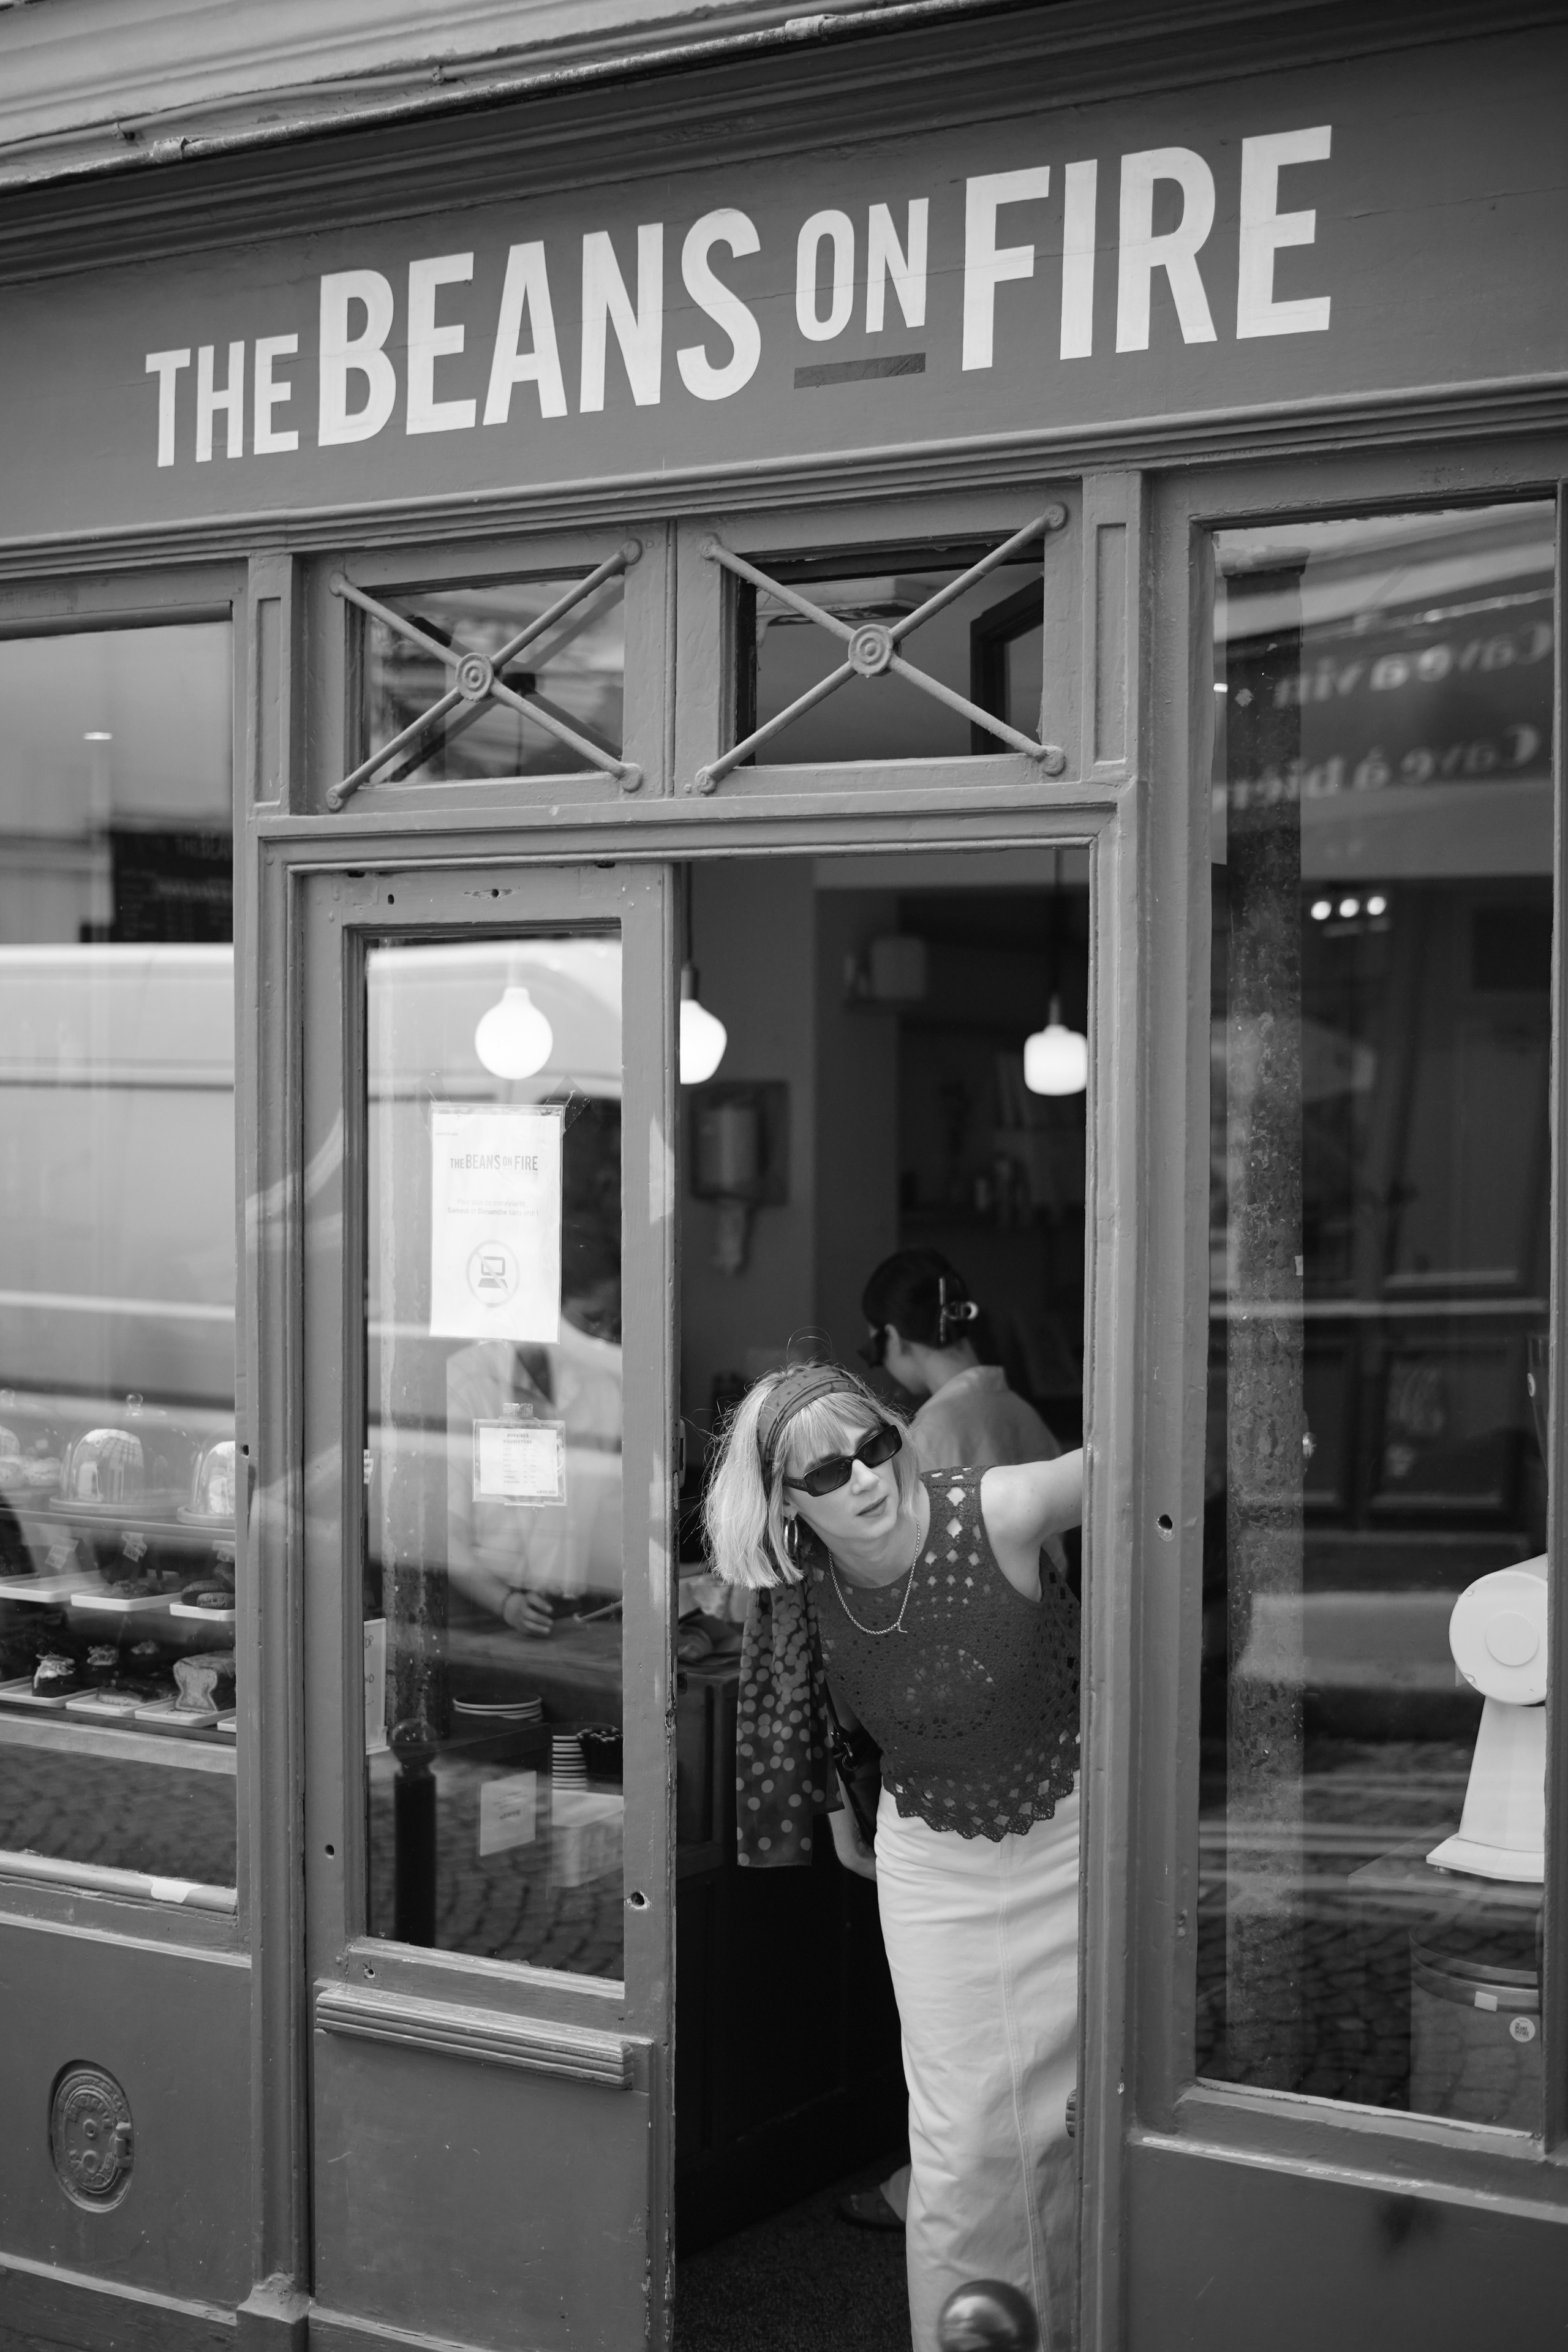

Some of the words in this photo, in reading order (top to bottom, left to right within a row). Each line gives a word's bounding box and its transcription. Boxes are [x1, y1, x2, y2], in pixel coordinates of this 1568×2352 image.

[146, 333, 299, 468] THE
[318, 208, 761, 447] BEANS
[796, 198, 929, 341] ON
[962, 126, 1332, 371] FIRE
[450, 1158, 464, 1169] THE
[466, 1154, 501, 1170] BEANS
[502, 1156, 513, 1167] ON
[514, 1156, 539, 1171] FIRE
